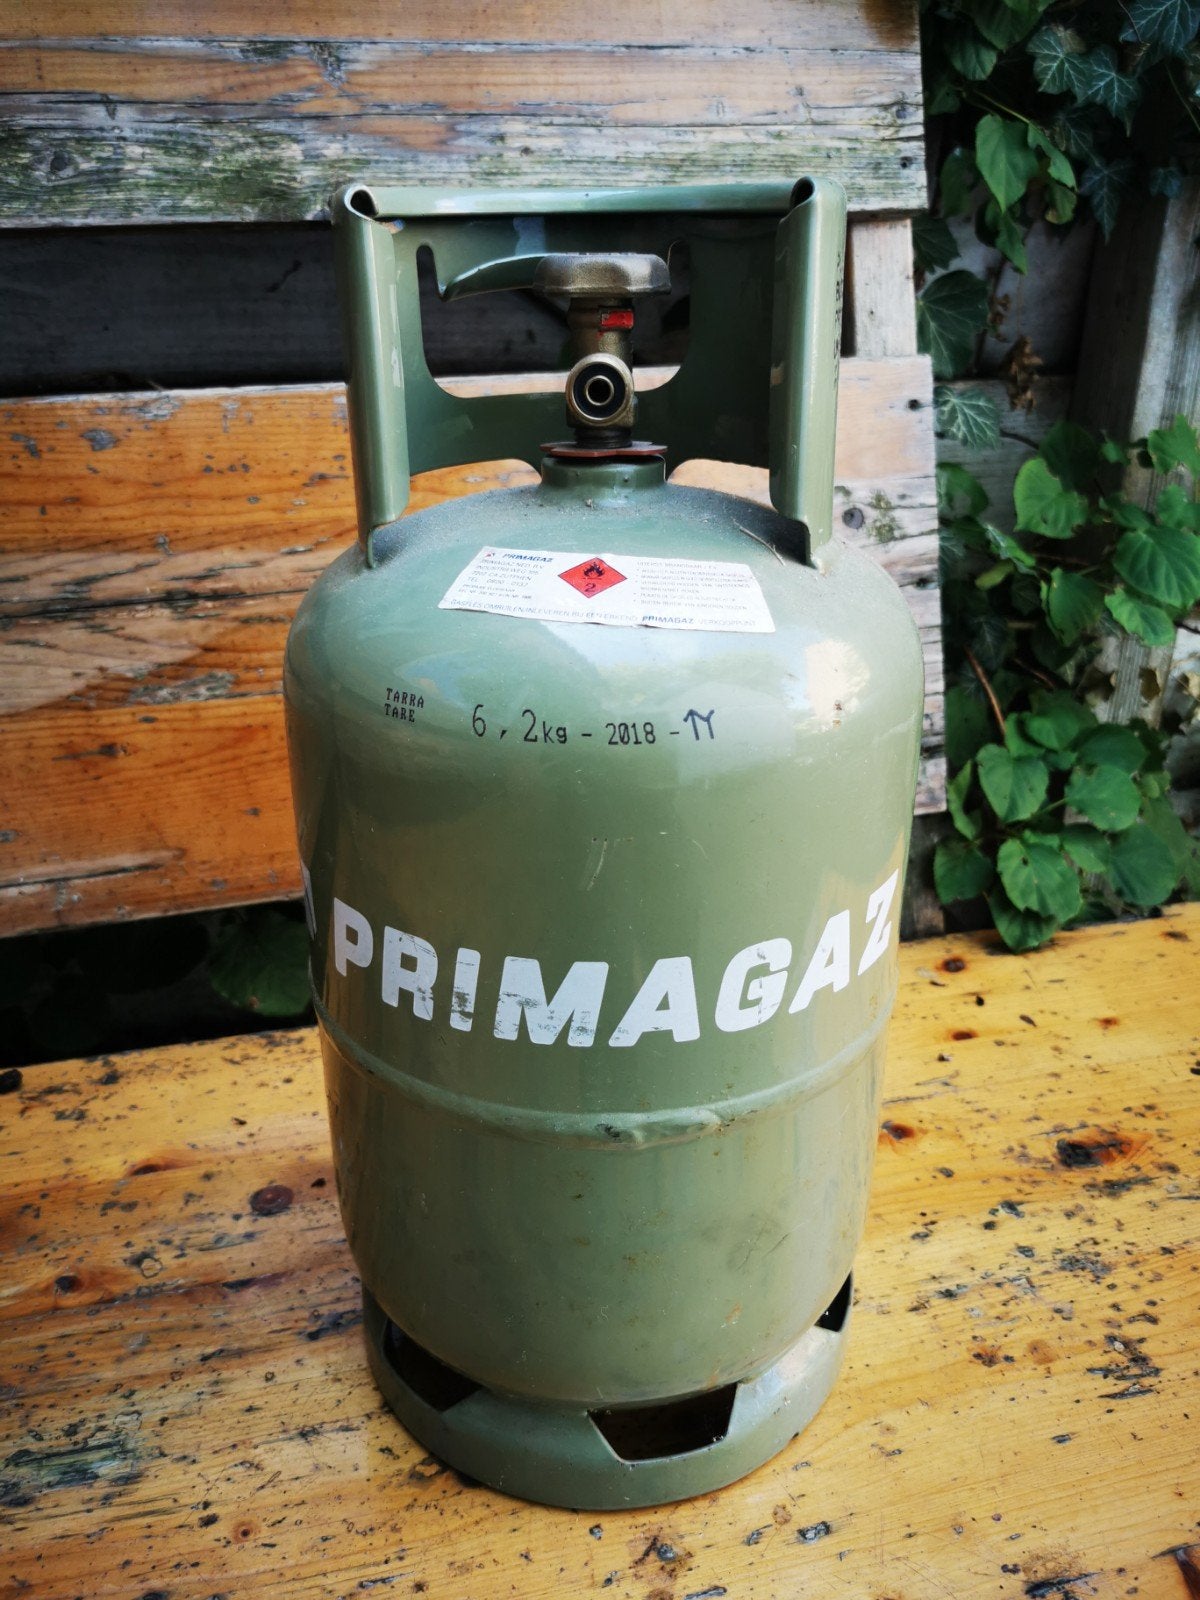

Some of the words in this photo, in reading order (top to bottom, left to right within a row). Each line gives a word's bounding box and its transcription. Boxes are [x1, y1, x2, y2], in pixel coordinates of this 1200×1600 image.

[502, 552, 554, 563] PRIMAGAZ
[584, 582, 597, 593] 2
[641, 615, 695, 625] PRIMAGAZ
[386, 687, 424, 709] TARRA
[384, 703, 415, 723] TARE
[605, 721, 656, 745] 2018
[333, 868, 899, 1048] PRIMAGAZ
